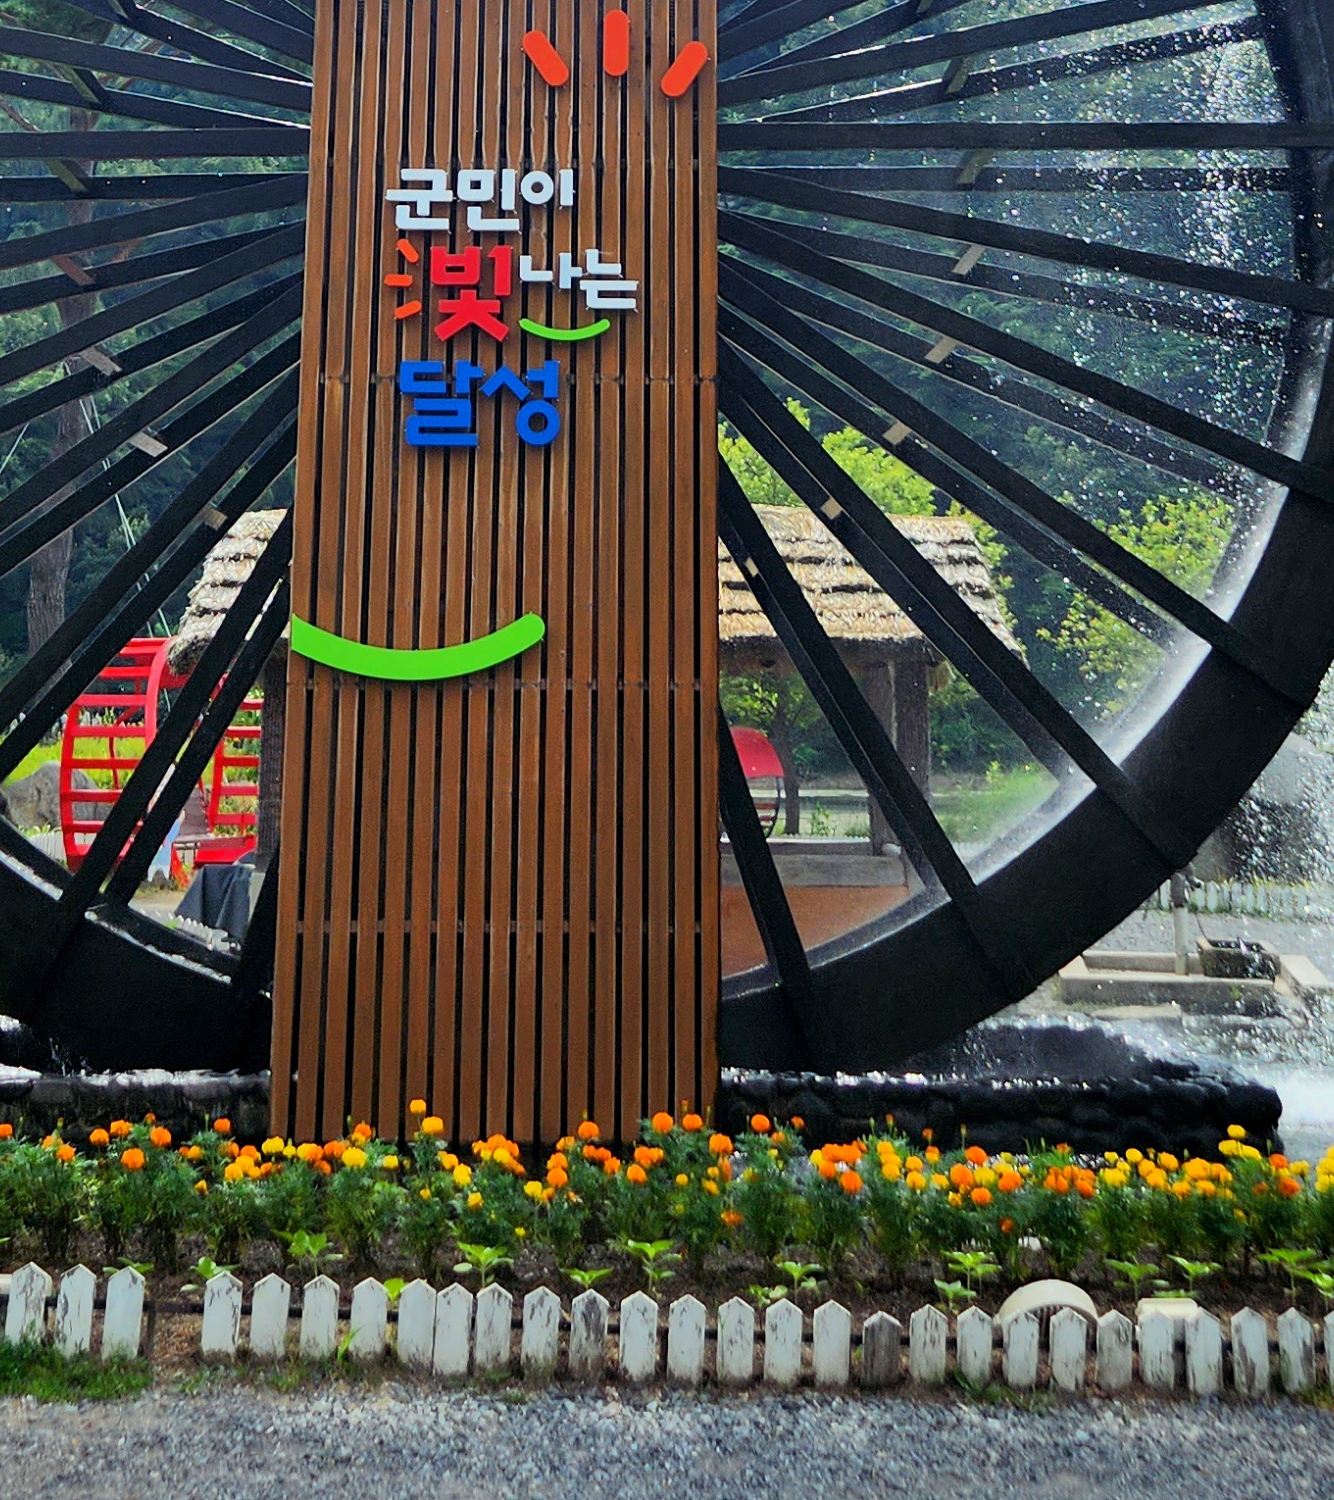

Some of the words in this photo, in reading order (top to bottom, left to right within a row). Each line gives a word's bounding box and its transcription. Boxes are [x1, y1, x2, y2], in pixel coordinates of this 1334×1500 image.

[386, 168, 574, 231] 군민이
[430, 244, 639, 342] 빛나는
[399, 359, 561, 446] 달성
